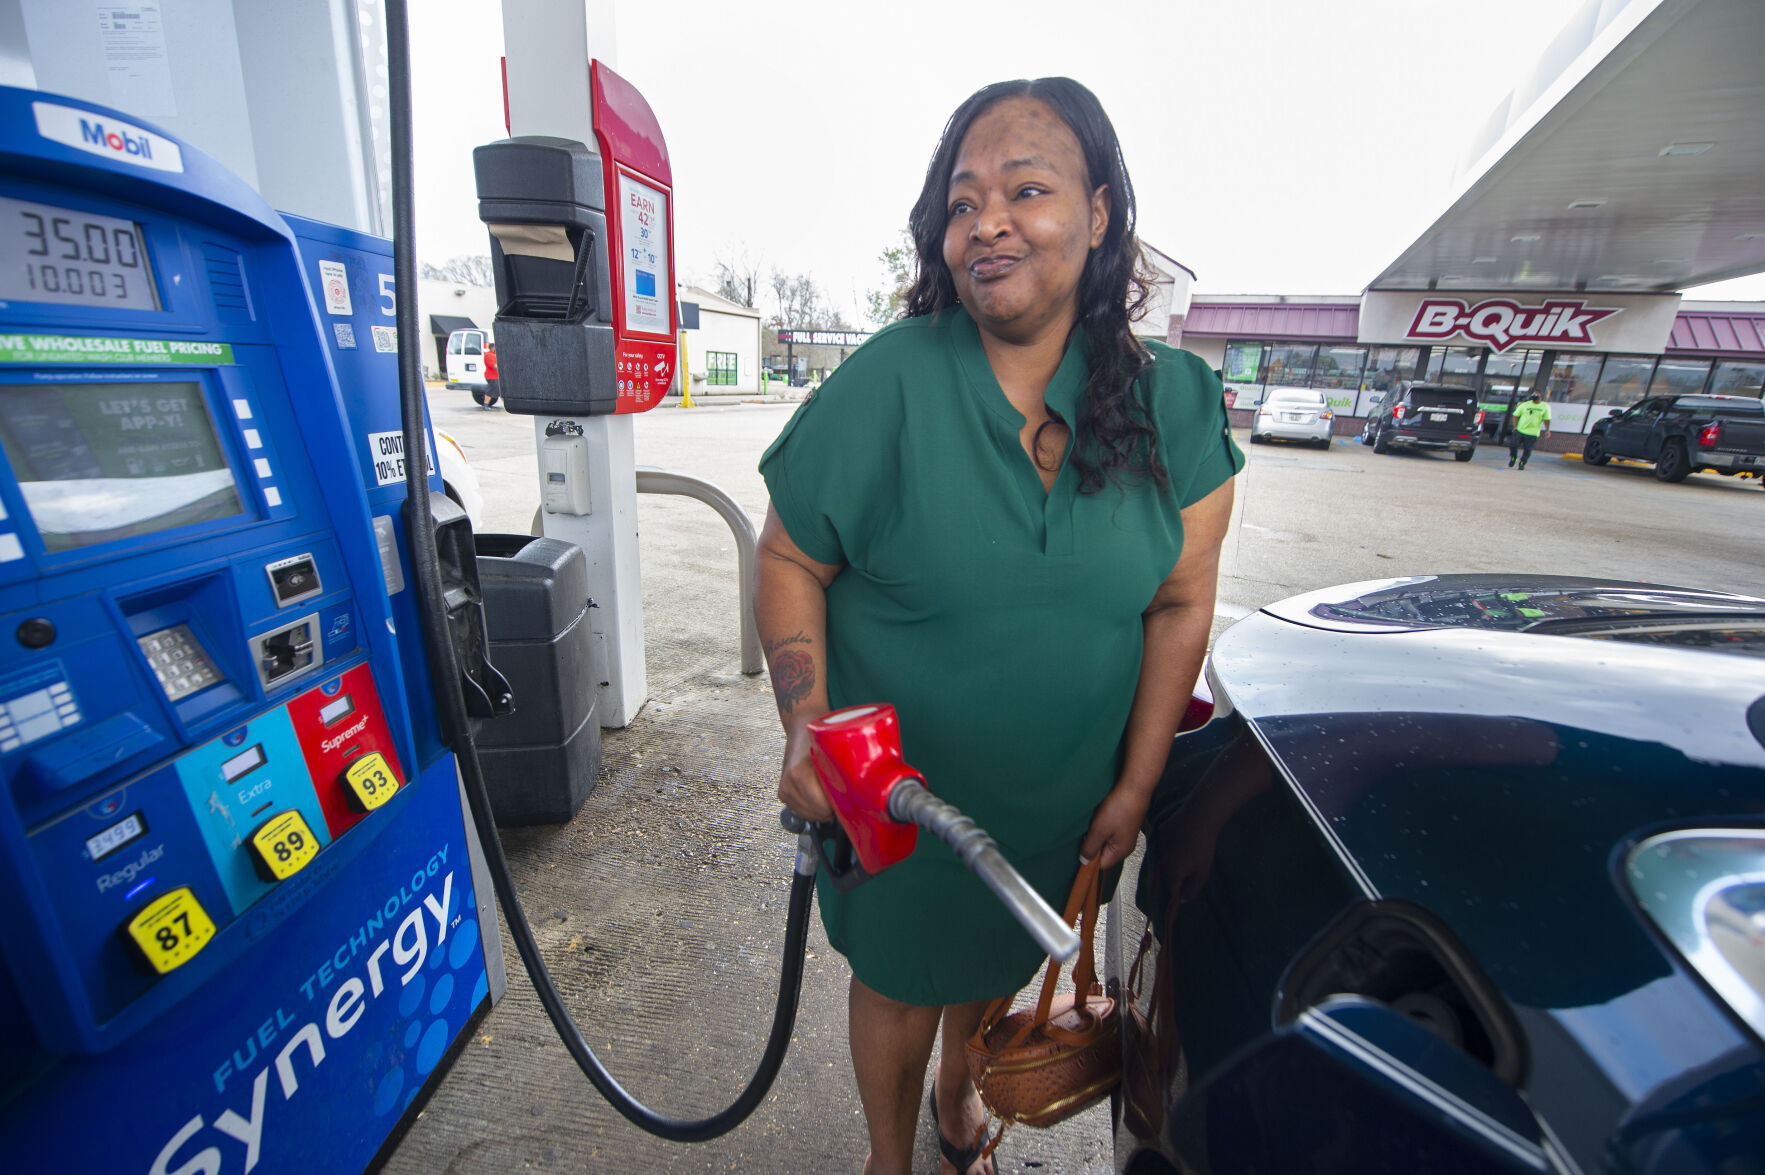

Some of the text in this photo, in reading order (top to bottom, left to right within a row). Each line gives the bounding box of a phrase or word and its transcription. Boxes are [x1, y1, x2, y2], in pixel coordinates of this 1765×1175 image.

[78, 118, 153, 160] Mobil
[630, 192, 655, 215] EARN
[638, 211, 649, 226] 42
[20, 210, 139, 268] 35.00
[640, 227, 649, 239] 30
[631, 248, 639, 259] 12
[648, 253, 655, 264] 10
[26, 263, 128, 299] 10.003
[378, 273, 397, 316] 5
[1415, 305, 1593, 342] B-Quik
[0, 336, 222, 355] VE WHOLESALE FUEL PRICING
[793, 331, 810, 343] FULL
[813, 332, 845, 344] SERVICE
[100, 398, 188, 415] LET'S GET
[121, 414, 183, 430] APP-Y!
[379, 435, 403, 455] CONT
[375, 460, 397, 480] 10%
[238, 778, 272, 805] Extra
[362, 770, 388, 796] 93
[273, 831, 304, 862] 89
[96, 844, 164, 893] Regular
[156, 911, 193, 951] 87
[212, 1008, 295, 1094] FUEL
[300, 843, 449, 1001] TECHNOLOGY
